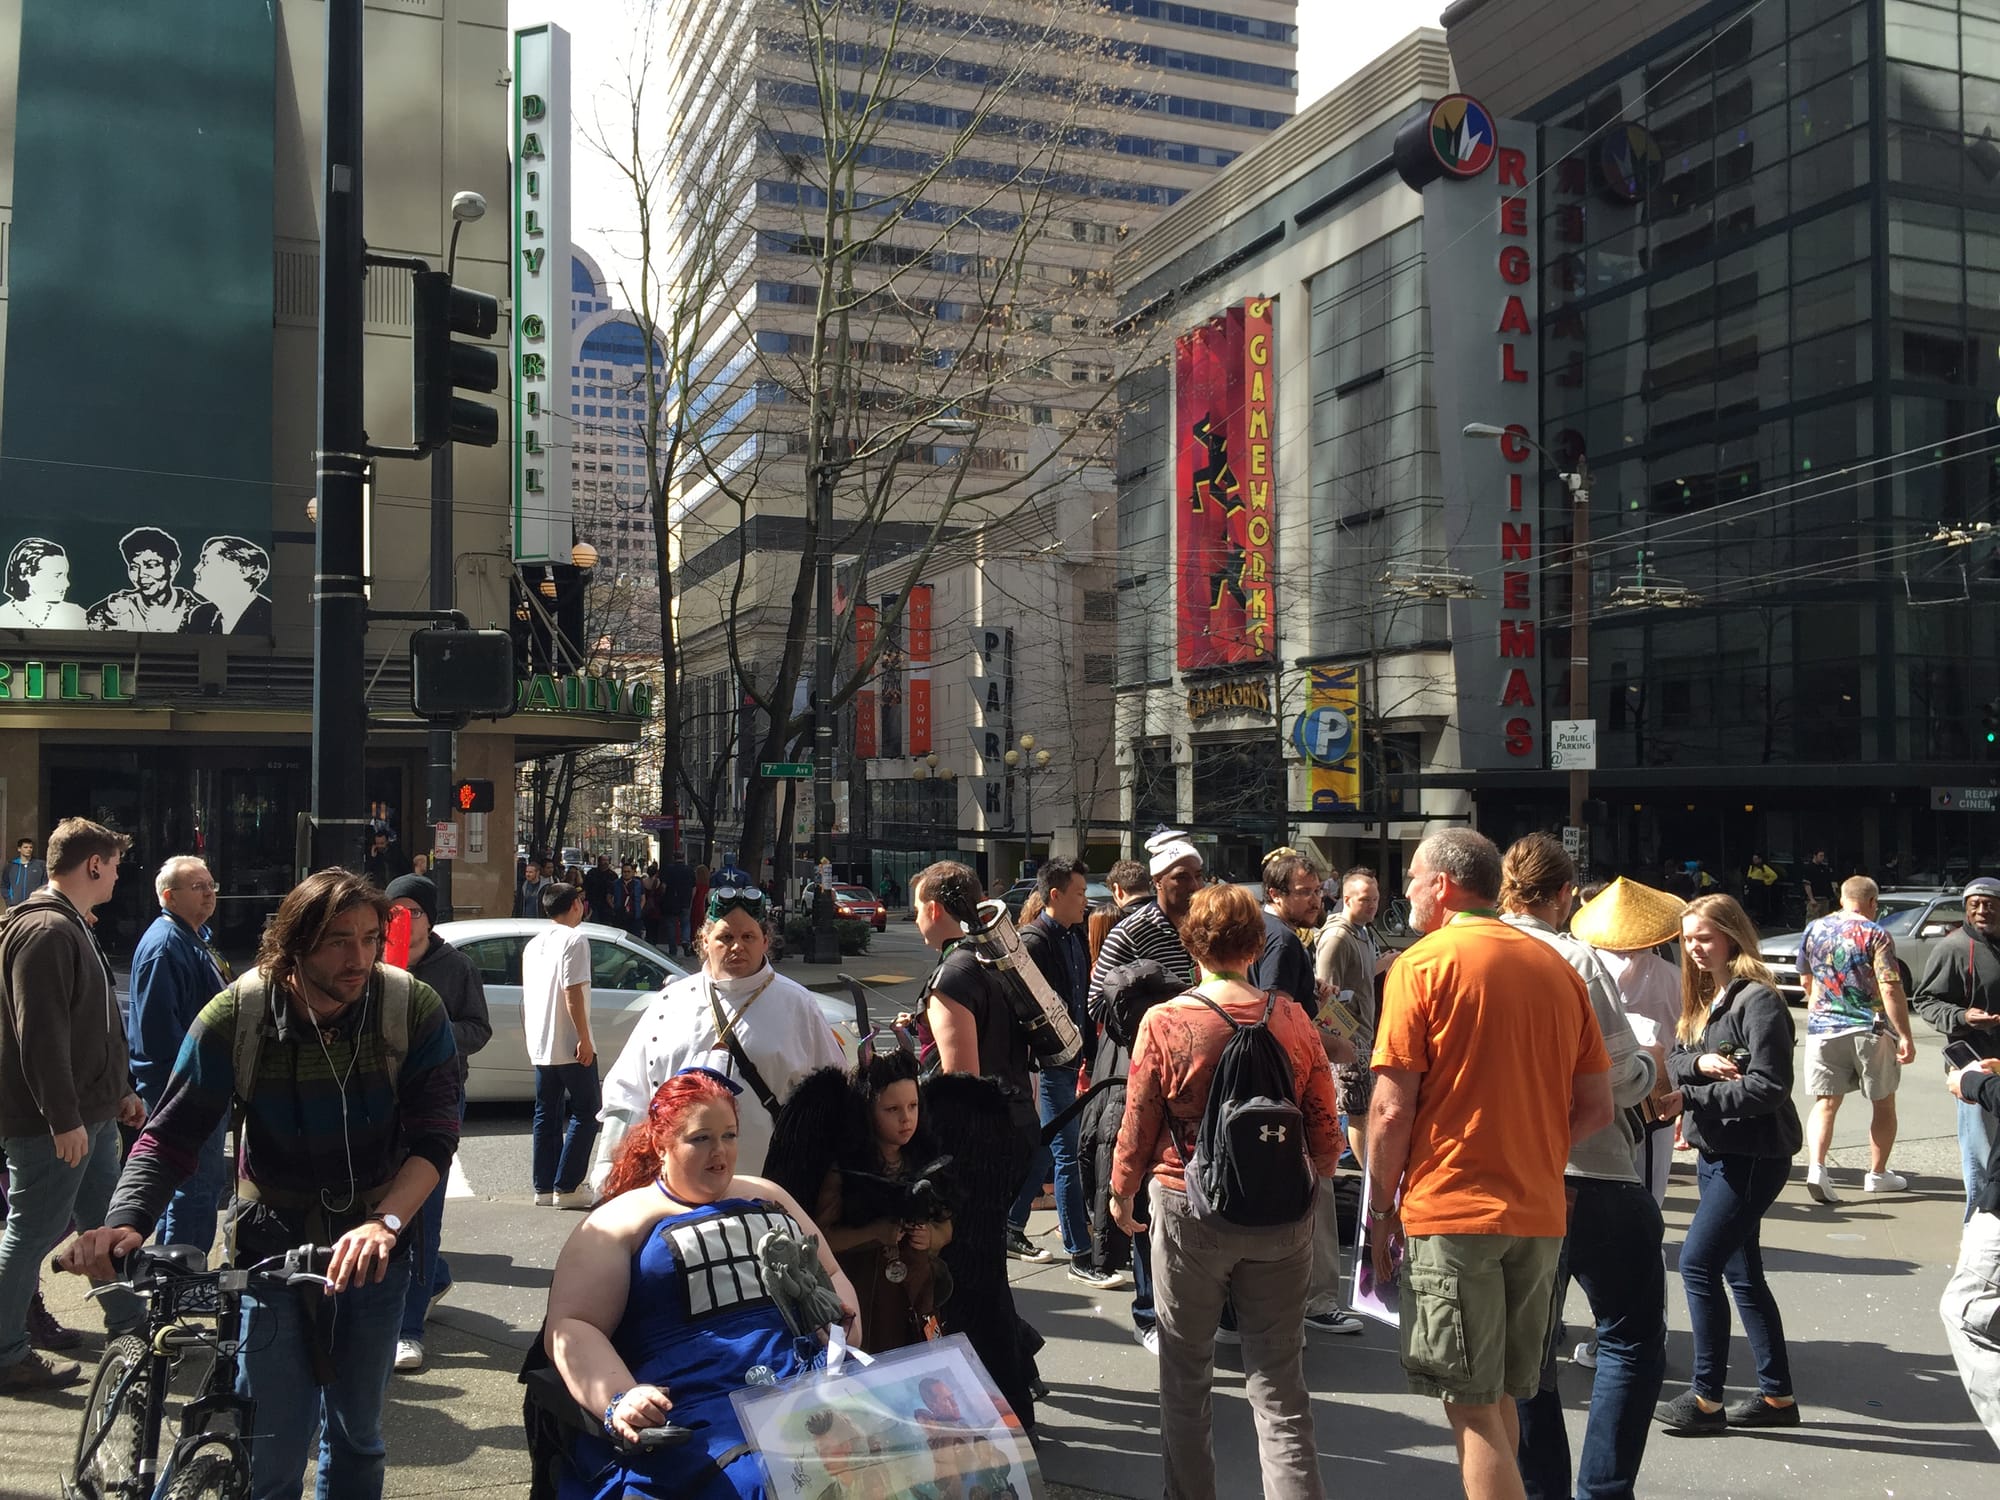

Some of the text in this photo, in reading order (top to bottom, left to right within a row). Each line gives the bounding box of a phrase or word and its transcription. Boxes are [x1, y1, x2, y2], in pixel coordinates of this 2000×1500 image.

[521, 95, 545, 493] DAILY GRILL
[1247, 334, 1270, 657] GAMEWORKS
[1498, 147, 1536, 757] REGAL CINEMAS
[518, 674, 625, 713] AILY
[916, 603, 926, 737] NIKE TOWN
[984, 632, 1001, 813] PARK
[1315, 711, 1348, 755] P
[1564, 829, 1578, 838] ONE
[1564, 839, 1578, 847] WAY
[748, 1365, 768, 1380] BAD
